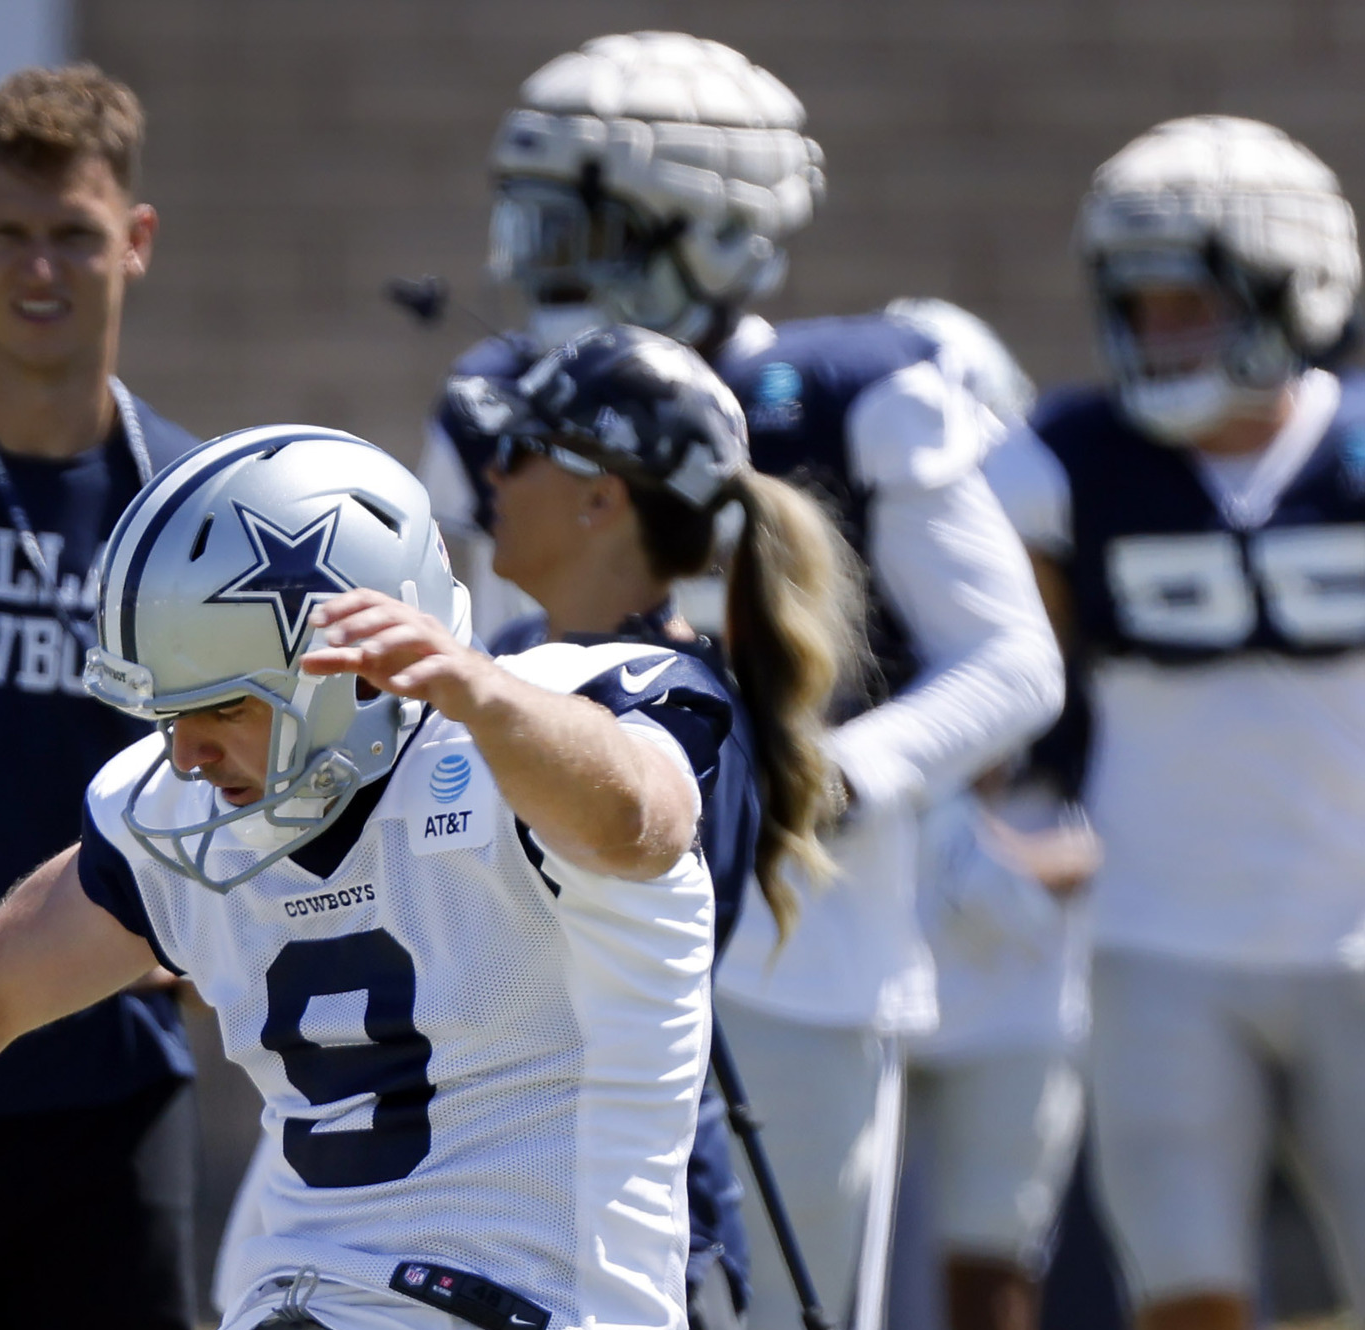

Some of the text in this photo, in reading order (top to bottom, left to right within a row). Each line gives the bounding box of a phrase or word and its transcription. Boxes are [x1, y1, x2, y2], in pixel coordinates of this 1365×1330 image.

[424, 809, 473, 839] AT&T
[284, 883, 376, 918] COWBOYS
[260, 927, 437, 1190] 9
